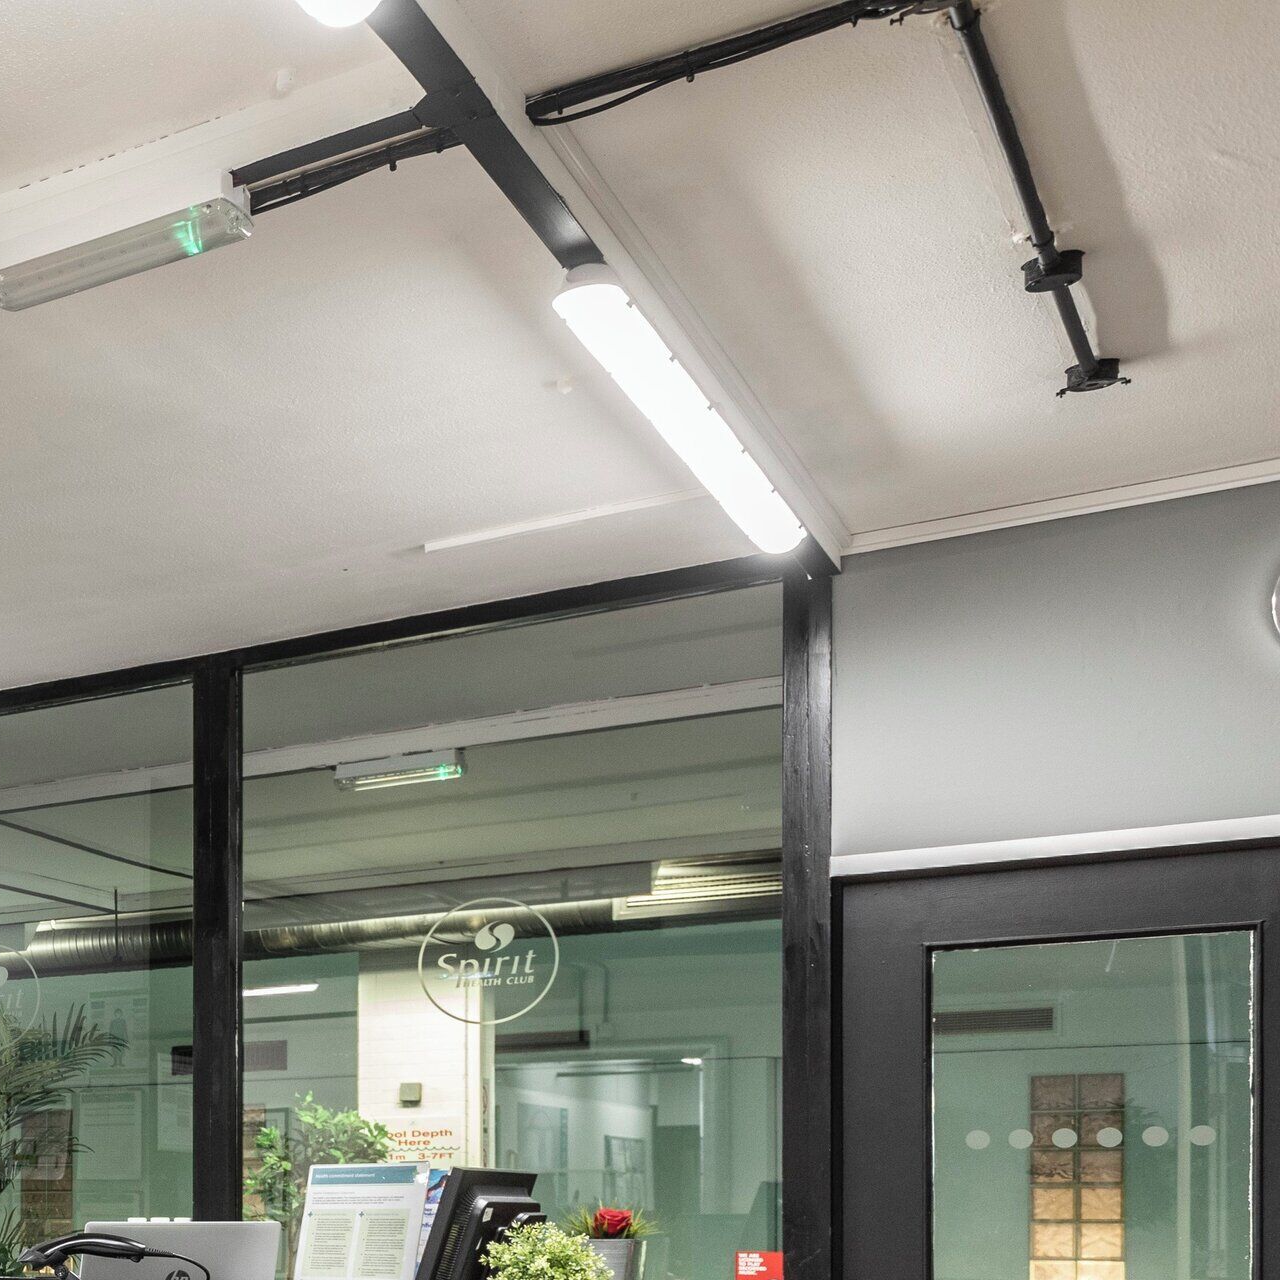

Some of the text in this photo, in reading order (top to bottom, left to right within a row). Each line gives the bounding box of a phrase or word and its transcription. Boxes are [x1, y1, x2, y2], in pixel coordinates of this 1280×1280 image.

[438, 949, 537, 988] Spirit
[506, 975, 534, 984] CLUB
[411, 1129, 453, 1139] Depth
[398, 1139, 431, 1147] Here
